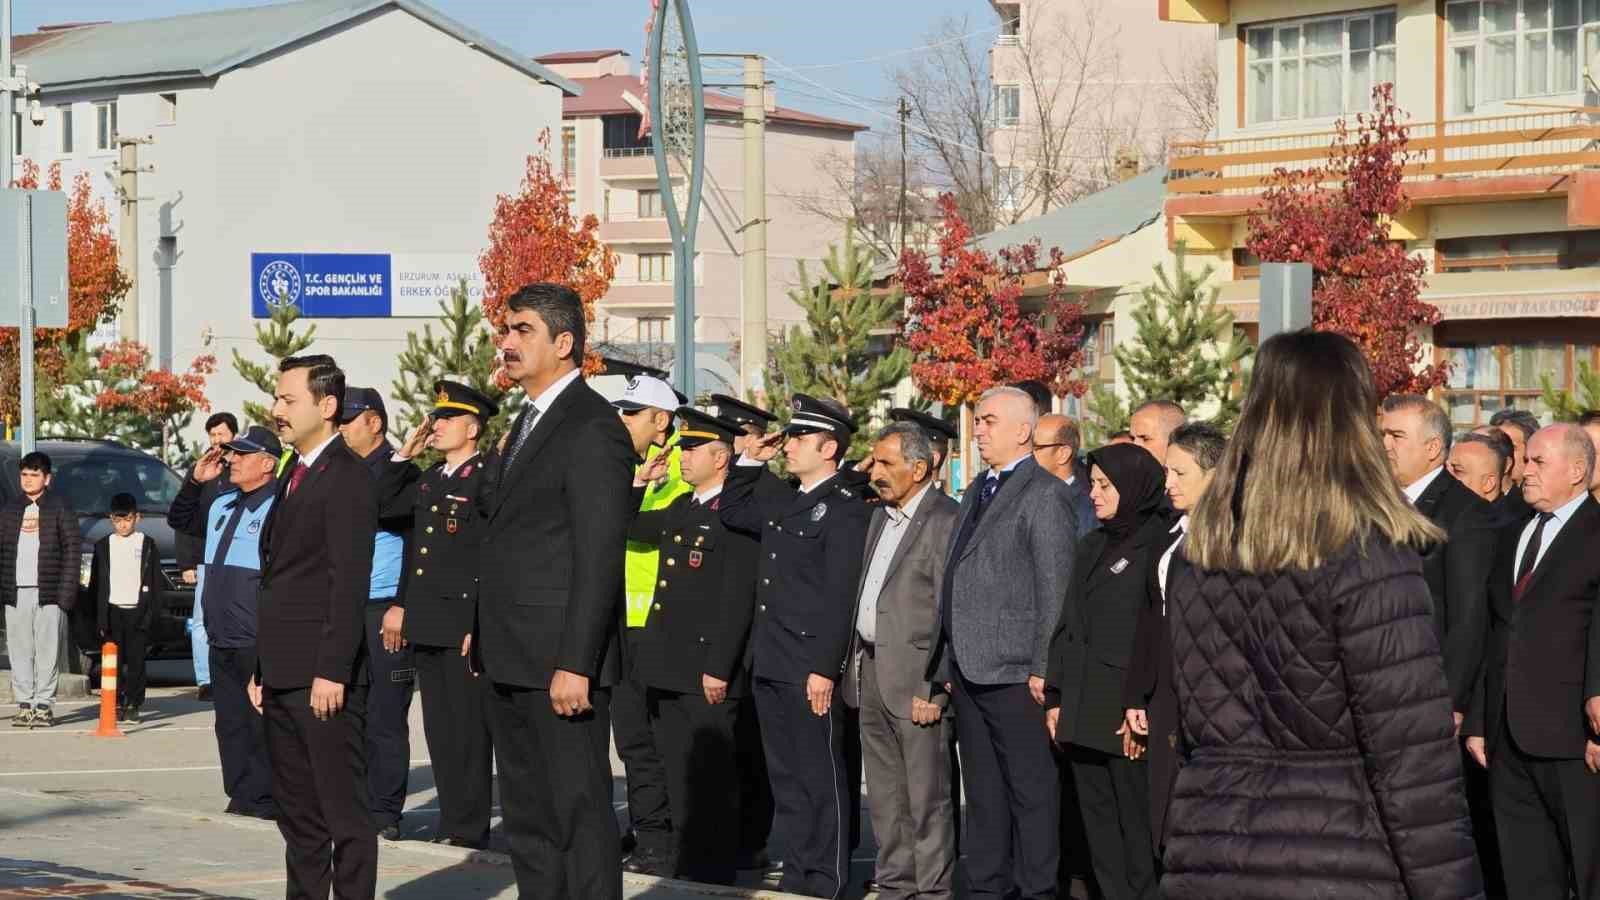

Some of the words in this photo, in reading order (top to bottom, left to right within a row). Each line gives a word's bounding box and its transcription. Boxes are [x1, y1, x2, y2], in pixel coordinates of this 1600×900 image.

[304, 273, 322, 284] T.C.
[324, 272, 366, 286] GENÇLİK
[369, 273, 382, 284] VE
[305, 286, 330, 296] SPOR
[332, 284, 383, 296] BAKANLIĞI
[400, 287, 432, 297] ERKEK
